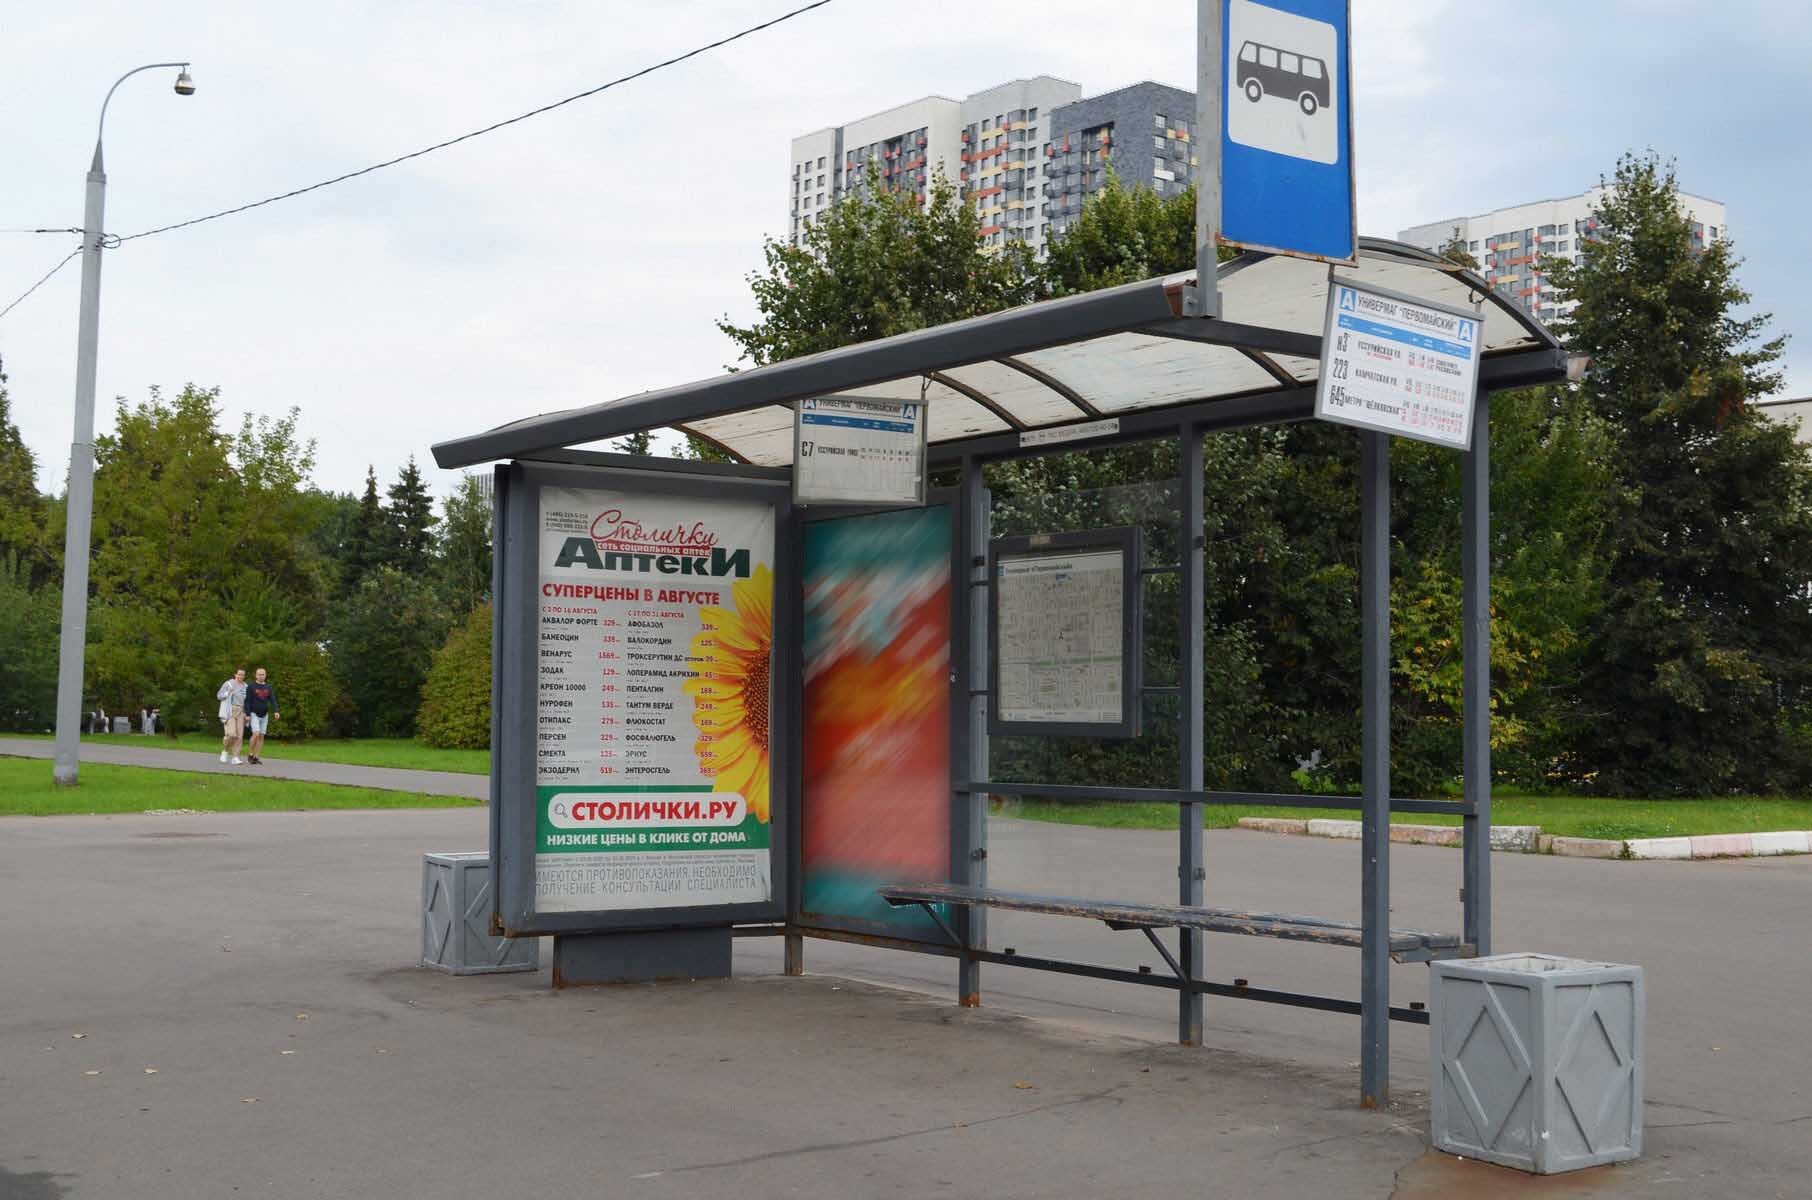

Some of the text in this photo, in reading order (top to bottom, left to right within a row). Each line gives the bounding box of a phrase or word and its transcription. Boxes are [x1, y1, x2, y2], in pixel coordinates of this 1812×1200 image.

[1333, 358, 1349, 380] 223
[1330, 385, 1345, 407] 645
[590, 509, 719, 546] Столички
[598, 542, 712, 556] сеть социальных аптек
[542, 584, 720, 605] СУПЕРЦЕНЫ В АВГУСТЕ
[542, 617, 575, 625] АКВАЛОР
[576, 618, 598, 626] ФОРТЕ
[628, 620, 664, 629] АФОБАЗОЛ
[627, 637, 672, 645] ВАЛОКОРДИН
[571, 801, 737, 821] СТОЛИЧКИ.РУ
[547, 832, 746, 846] НИЗКИЕ ЦЕНЫ В КЛИКЕ ОТ ДОМА
[692, 864, 756, 878] НЕОБХОДИМО
[536, 878, 756, 896] ПОЛУЧЕНИЕ КОНСУЛЬТАЦИИ СПЕЦИАЛИСТА
